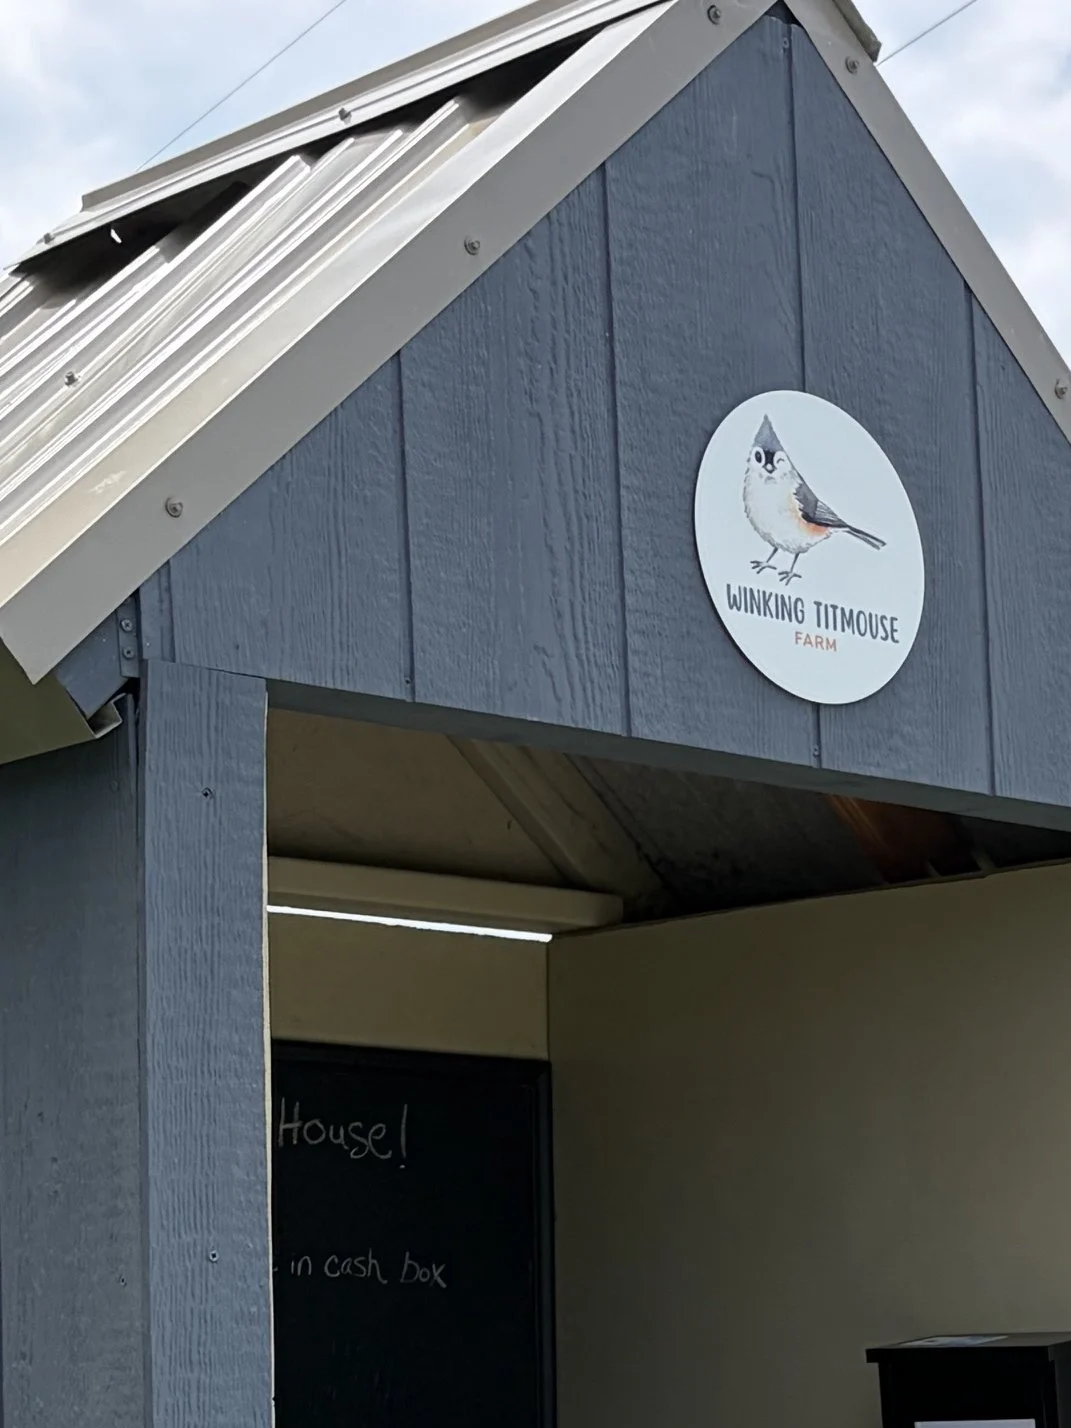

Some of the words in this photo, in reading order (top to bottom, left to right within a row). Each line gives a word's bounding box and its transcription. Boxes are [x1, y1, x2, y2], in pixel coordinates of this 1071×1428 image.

[726, 583, 805, 624] WINKING
[813, 600, 899, 643] TITMOUSE
[794, 631, 837, 651] FARM
[278, 1097, 408, 1169] House!
[290, 1255, 312, 1276] in
[323, 1248, 388, 1284] cash
[399, 1251, 447, 1288] box
